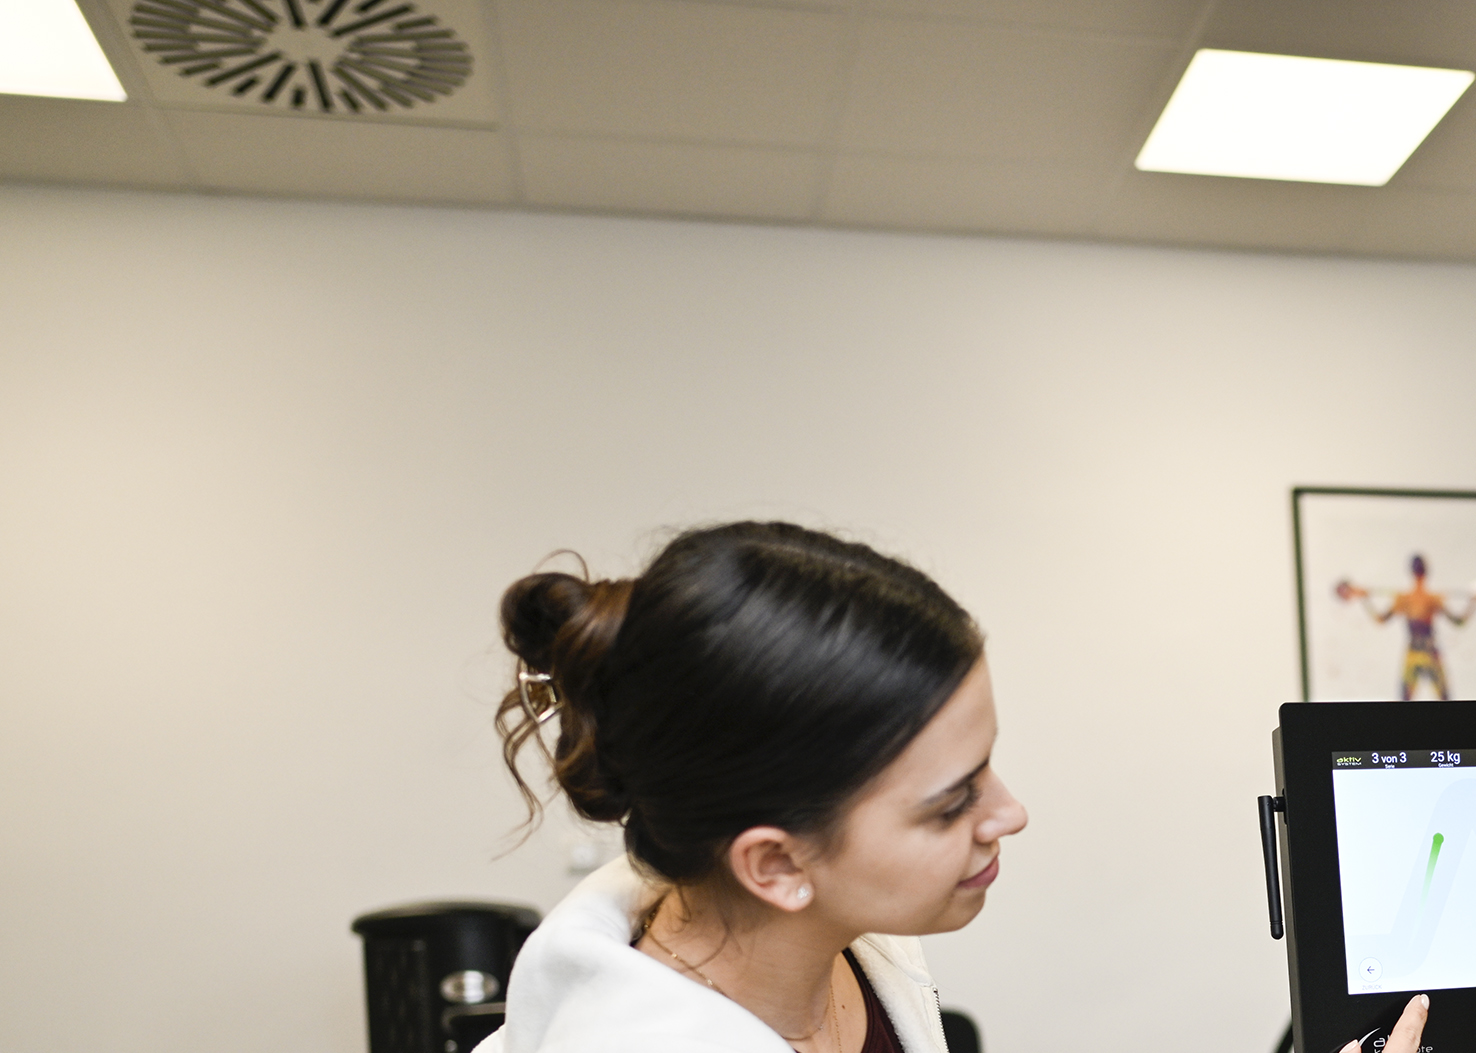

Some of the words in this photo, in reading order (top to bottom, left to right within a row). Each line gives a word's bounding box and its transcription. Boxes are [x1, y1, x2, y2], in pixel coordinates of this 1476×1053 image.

[1371, 752, 1379, 763] 3
[1381, 754, 1397, 763] von
[1399, 752, 1407, 763] 3
[1430, 751, 1445, 763] 25
[1447, 750, 1461, 764] kg
